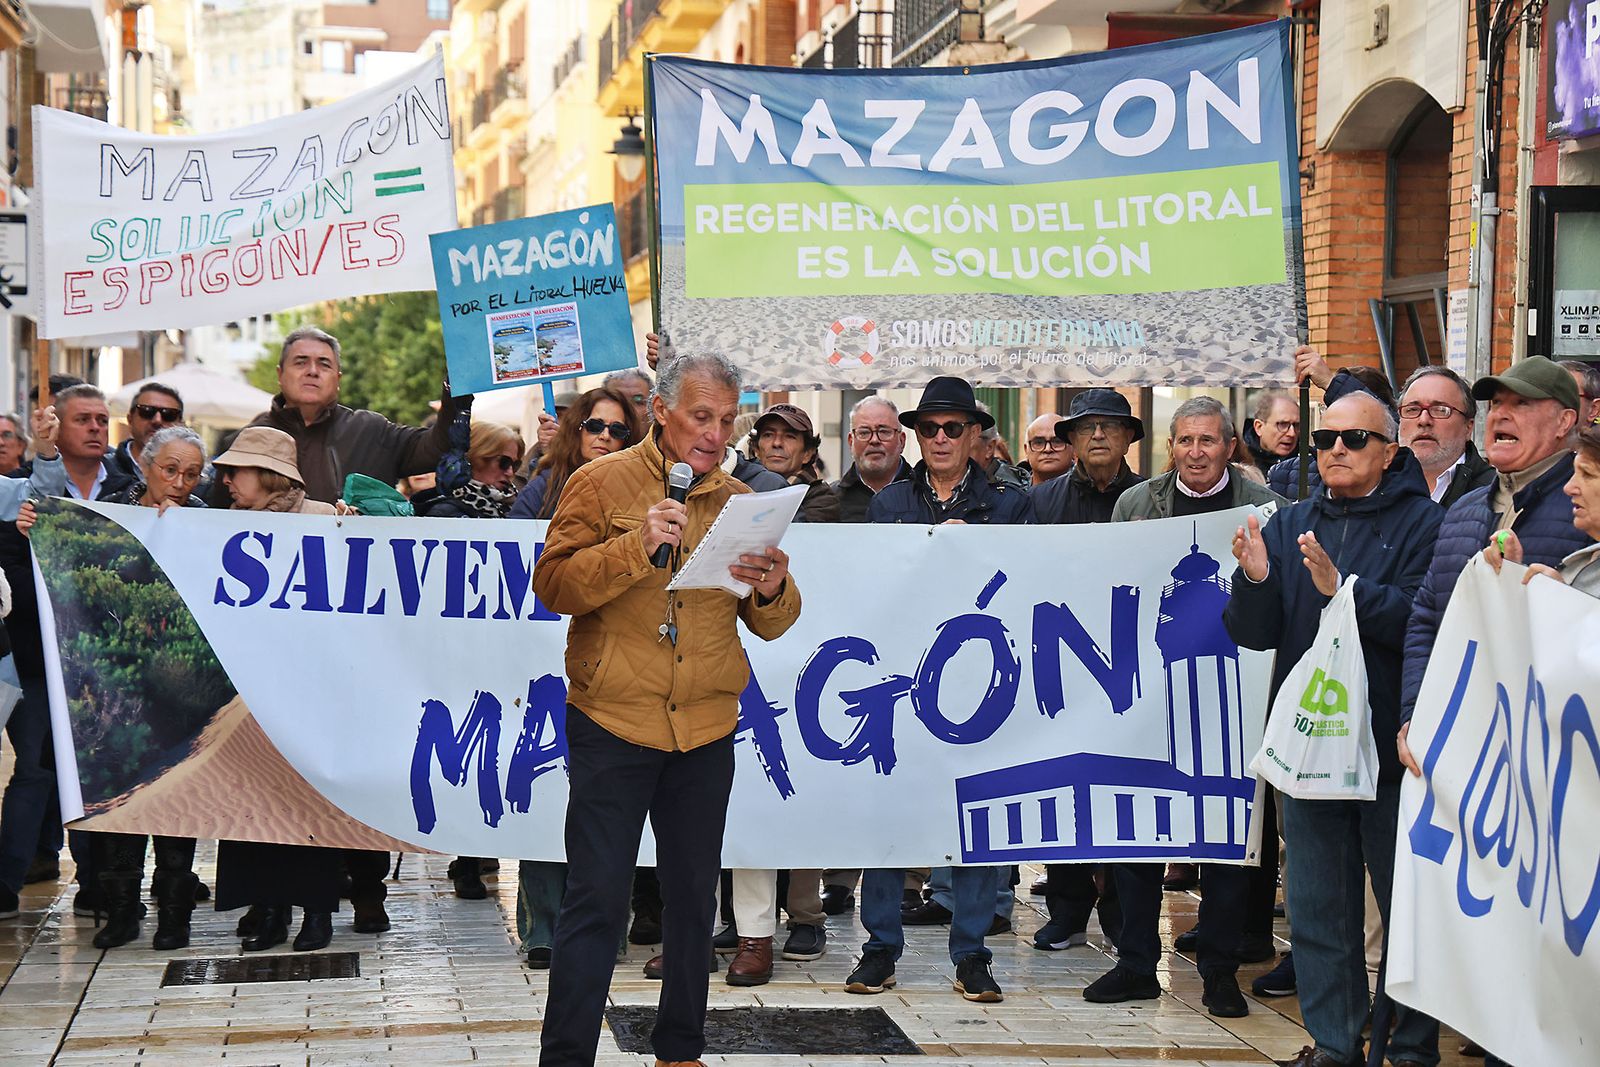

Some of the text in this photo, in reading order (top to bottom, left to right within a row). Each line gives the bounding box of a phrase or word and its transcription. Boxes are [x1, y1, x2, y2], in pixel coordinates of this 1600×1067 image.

[695, 57, 1261, 171] MAZAGON
[695, 186, 1273, 235] REGENERACIÓN DEL LITORAL
[63, 214, 405, 315] ESPIGÓN/ES
[448, 211, 614, 286] MAZAGÓN
[798, 236, 1151, 280] ES LA SOLUCIÓN
[450, 300, 482, 317] POR
[488, 293, 508, 310] EL
[573, 275, 625, 299] HUELVA
[1561, 306, 1589, 315] XLIM
[890, 354, 917, 368] nos
[922, 353, 976, 367] unimos
[980, 353, 1005, 368] por
[1009, 350, 1022, 364] el
[410, 569, 1142, 834] MAAGÓN
